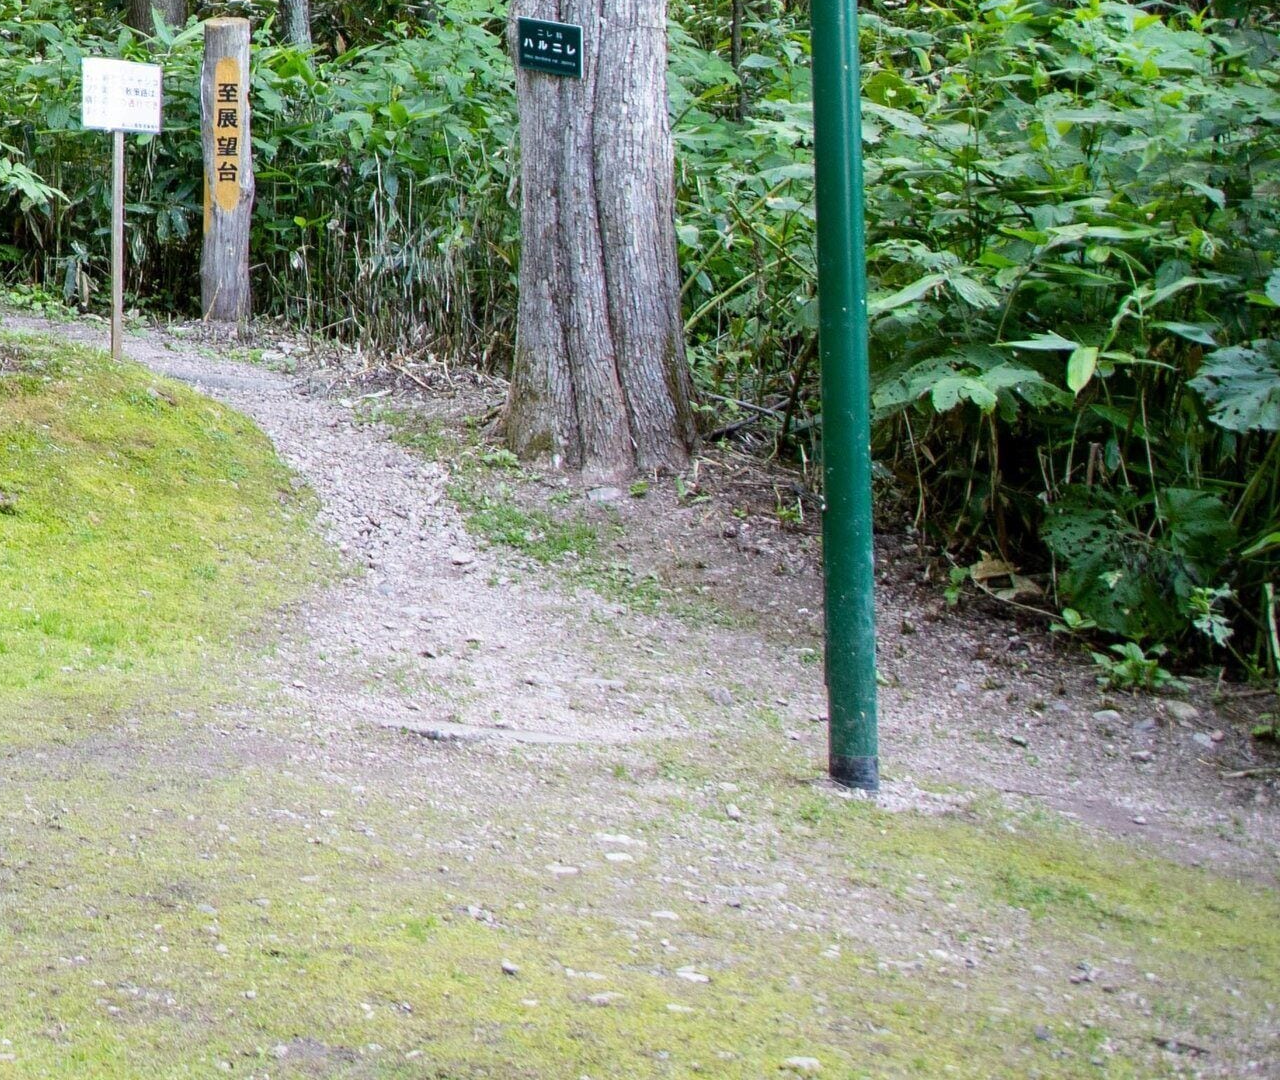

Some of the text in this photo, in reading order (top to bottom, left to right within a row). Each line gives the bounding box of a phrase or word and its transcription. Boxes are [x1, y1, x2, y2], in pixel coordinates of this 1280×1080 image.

[524, 38, 575, 55] ハルニレ
[216, 82, 239, 183] 至展望台
